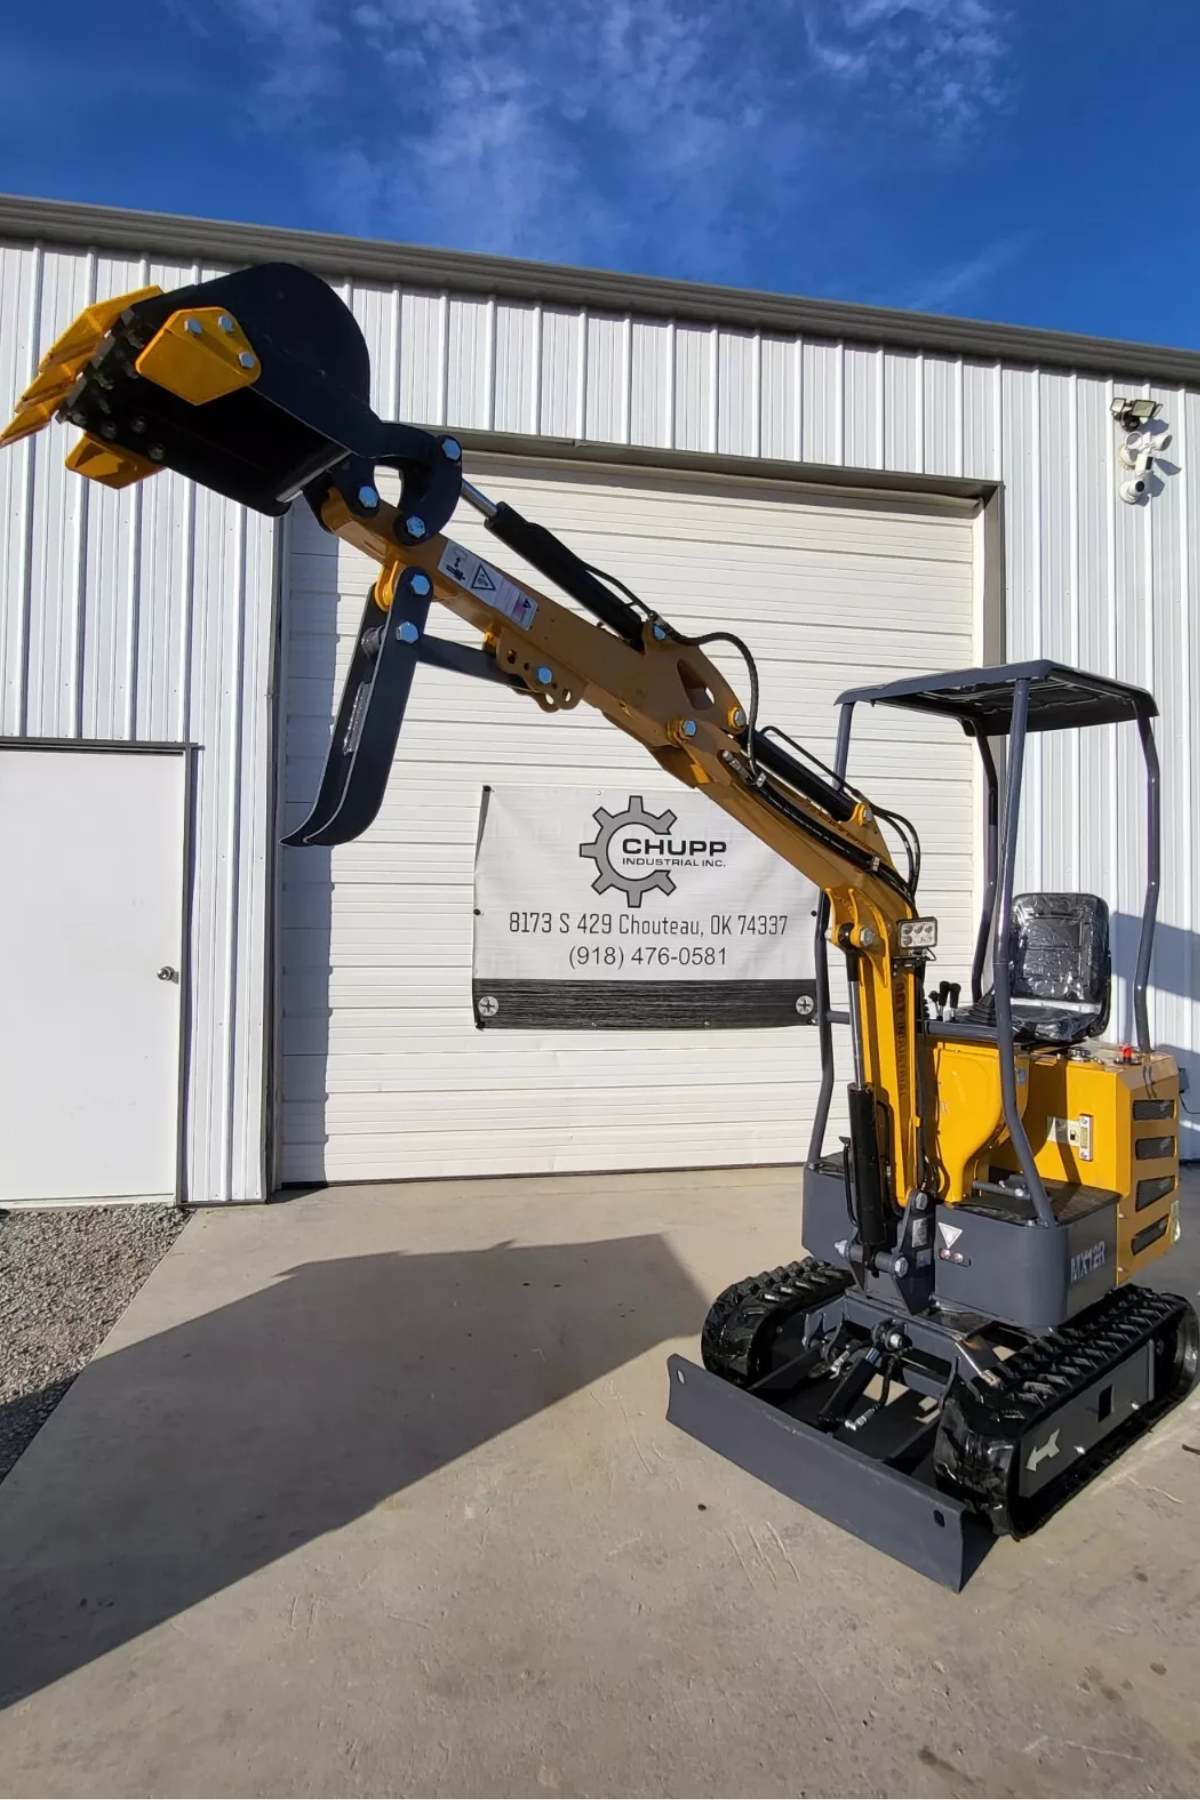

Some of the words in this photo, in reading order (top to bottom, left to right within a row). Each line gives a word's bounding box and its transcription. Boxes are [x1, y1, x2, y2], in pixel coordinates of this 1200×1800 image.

[622, 838, 727, 856] CHUPP
[622, 857, 699, 866] INDUSTRIAL
[701, 859, 726, 867] INC.
[509, 911, 552, 933] 8173
[559, 913, 570, 933] S
[577, 913, 612, 934] 429
[619, 913, 704, 937] Chouteau,
[710, 914, 732, 935] OK
[737, 915, 788, 935] 74337
[569, 945, 624, 970] (918)
[630, 946, 726, 965] 476-0581
